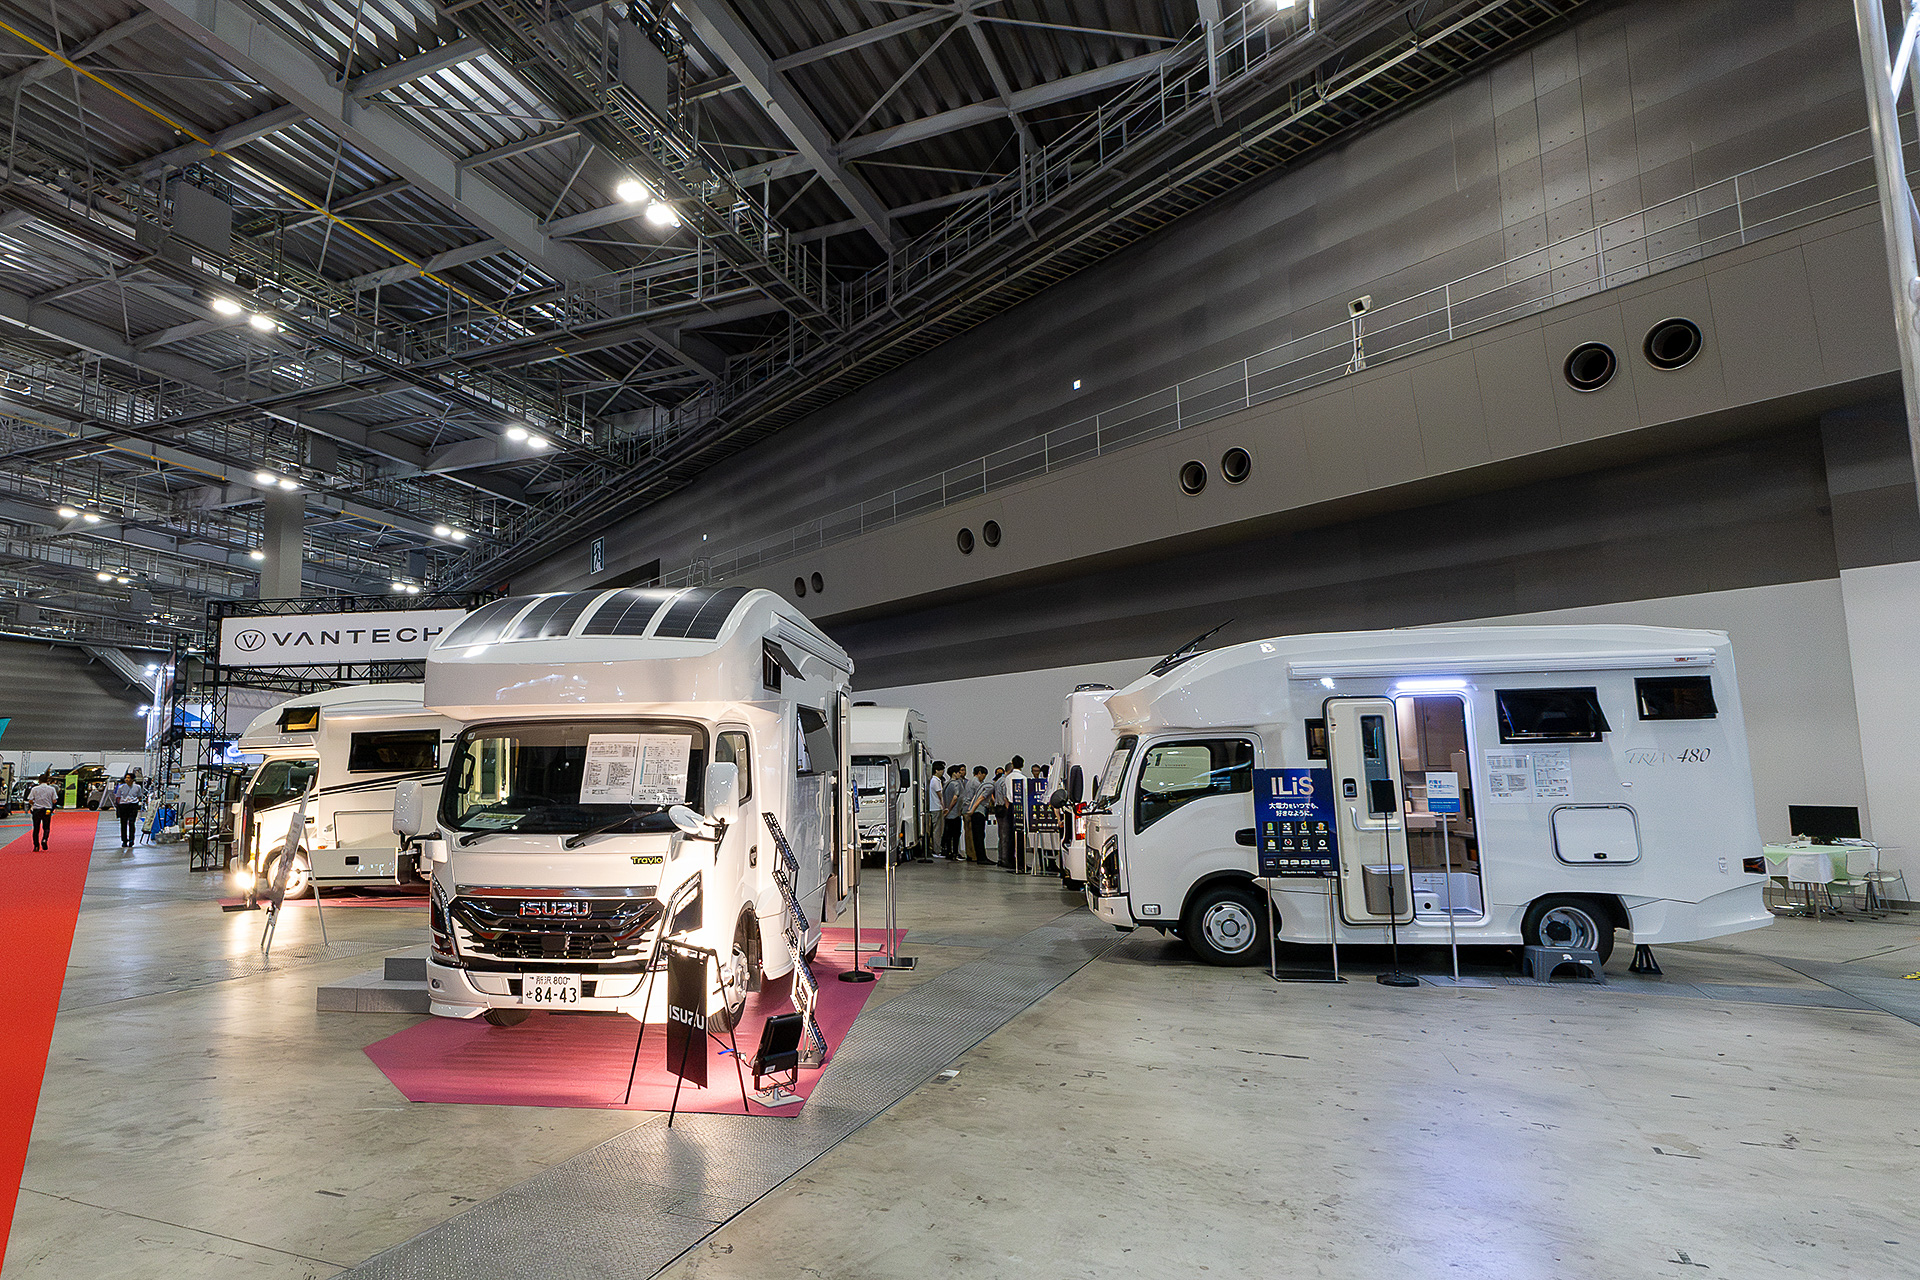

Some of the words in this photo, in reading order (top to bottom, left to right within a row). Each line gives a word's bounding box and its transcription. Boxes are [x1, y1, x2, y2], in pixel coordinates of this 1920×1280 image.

[272, 626, 443, 646] VANTECH
[1677, 747, 1711, 763] 480
[1271, 776, 1315, 795] ILiS
[632, 856, 663, 865] Travio
[519, 901, 589, 916] ISUZU
[552, 976, 568, 985] 800
[535, 986, 577, 1003] 84-43
[669, 1004, 705, 1030] ISUZU
